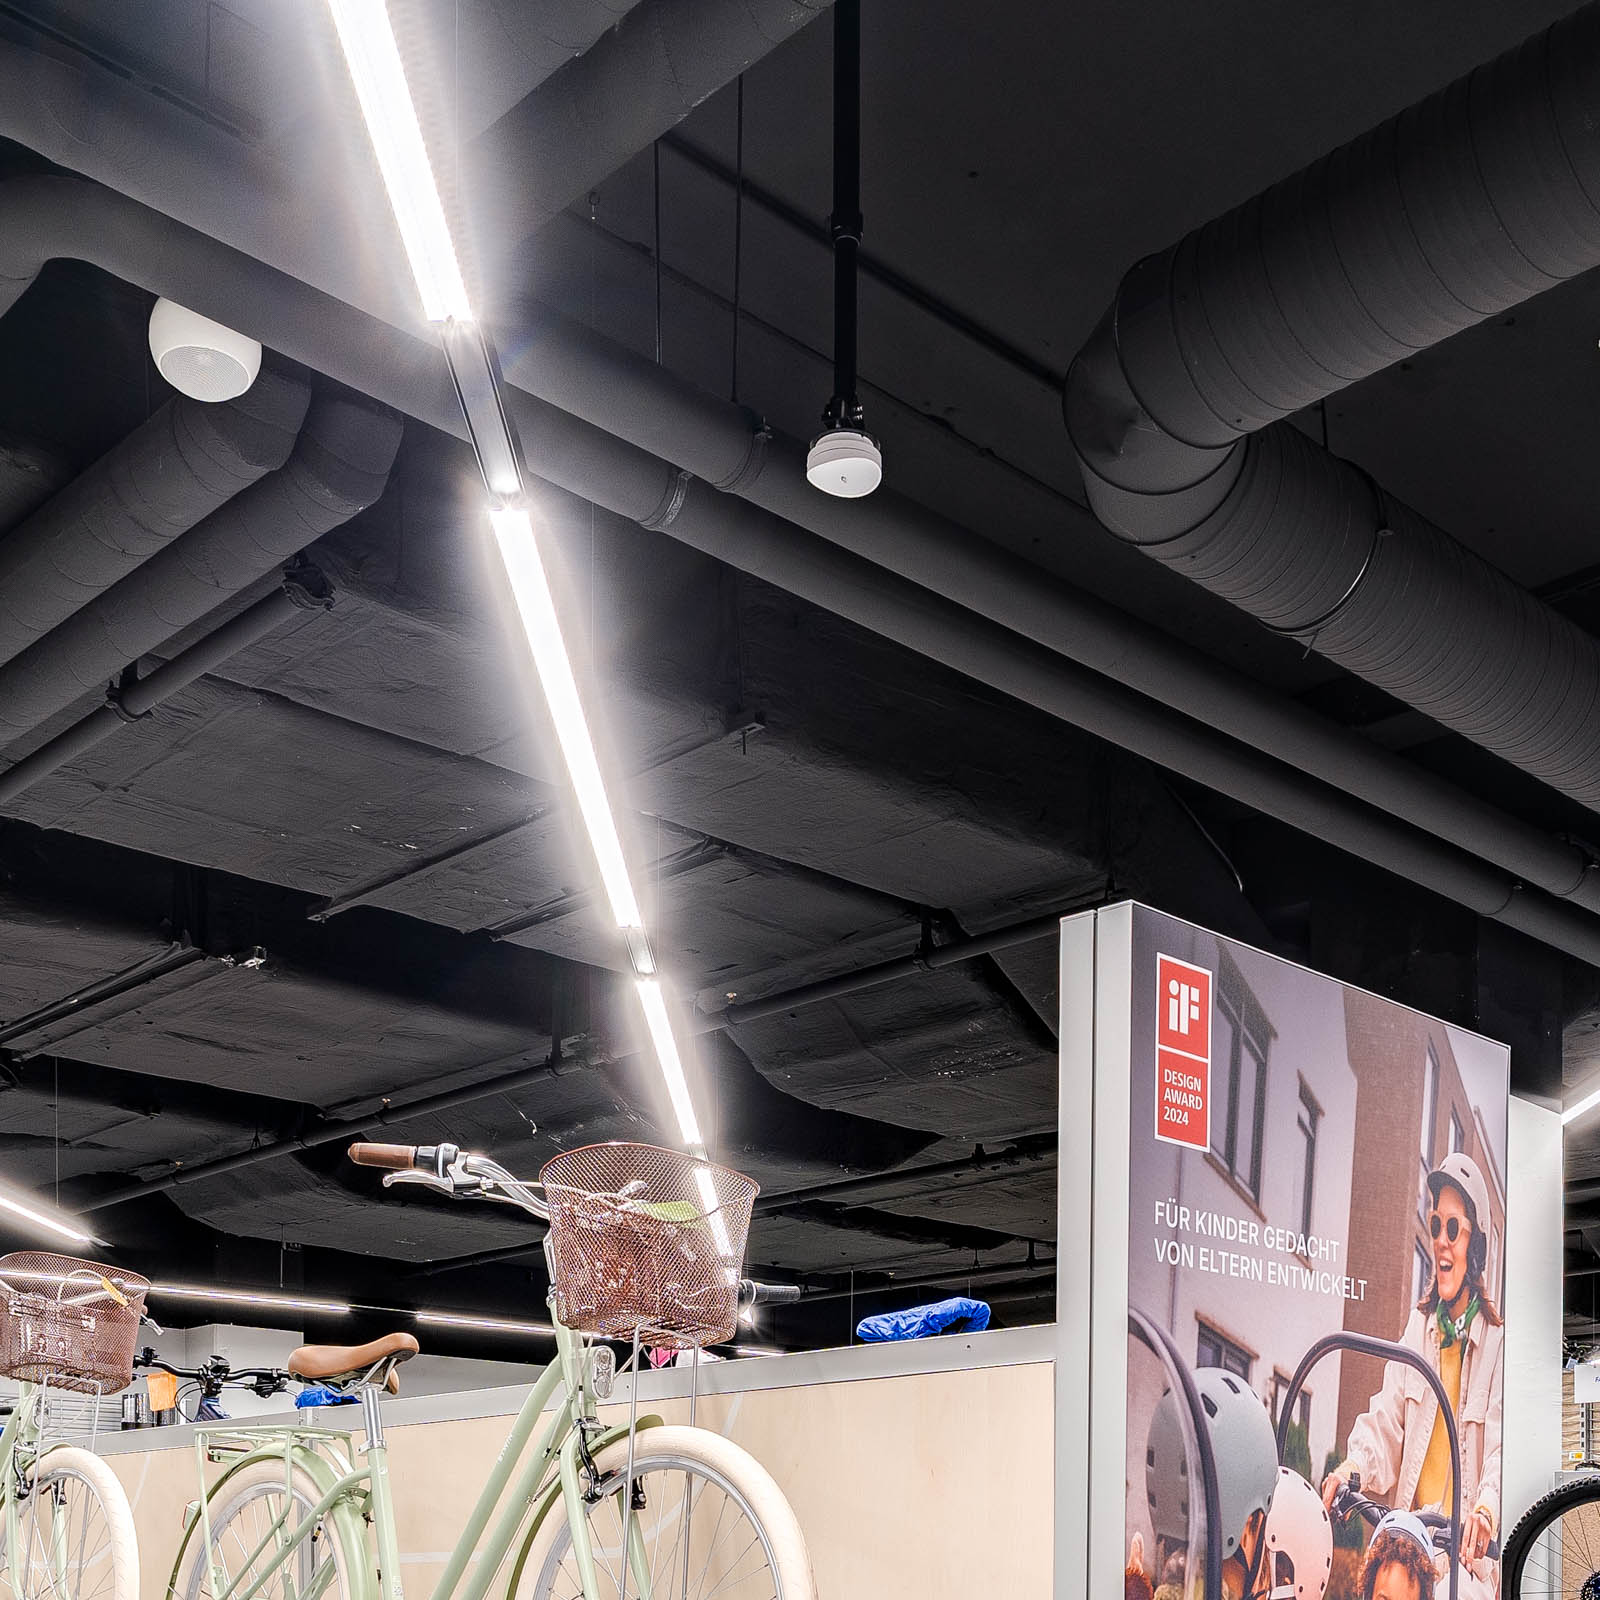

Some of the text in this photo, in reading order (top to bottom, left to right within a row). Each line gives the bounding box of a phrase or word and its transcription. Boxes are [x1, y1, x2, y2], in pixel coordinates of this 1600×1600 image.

[1163, 1067, 1202, 1093] DESIGN
[1163, 1088, 1203, 1111] AWARD
[1163, 1104, 1190, 1126] 2024
[1154, 1197, 1340, 1263] FÜR KINDER GEDACHT
[1154, 1238, 1368, 1303] VON ELTERN ENTWICKELT
